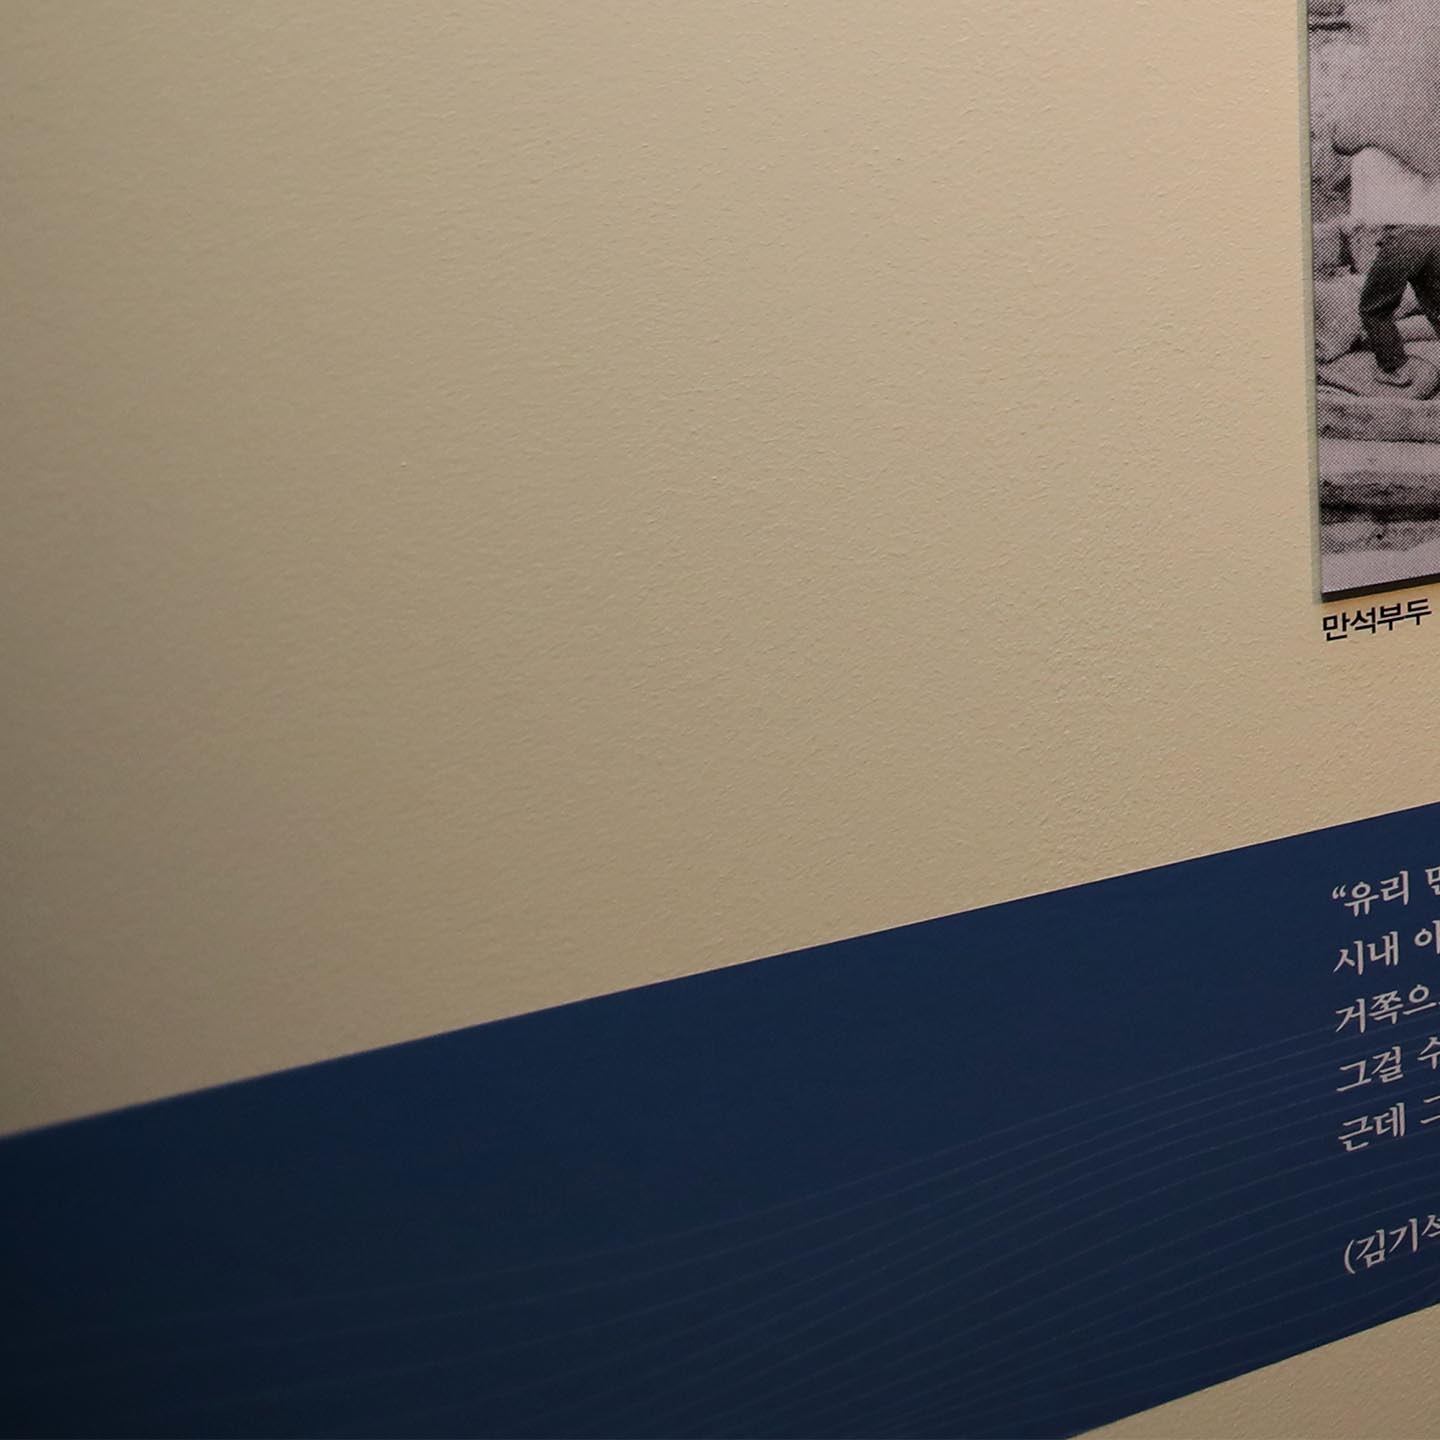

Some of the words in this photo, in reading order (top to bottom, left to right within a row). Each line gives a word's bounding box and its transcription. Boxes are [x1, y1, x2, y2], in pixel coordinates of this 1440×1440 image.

[1322, 597, 1433, 643] 만석부두
[1332, 930, 1400, 976] 시내
[1335, 1045, 1404, 1093] 그걸
[1337, 1101, 1406, 1153] 근데
